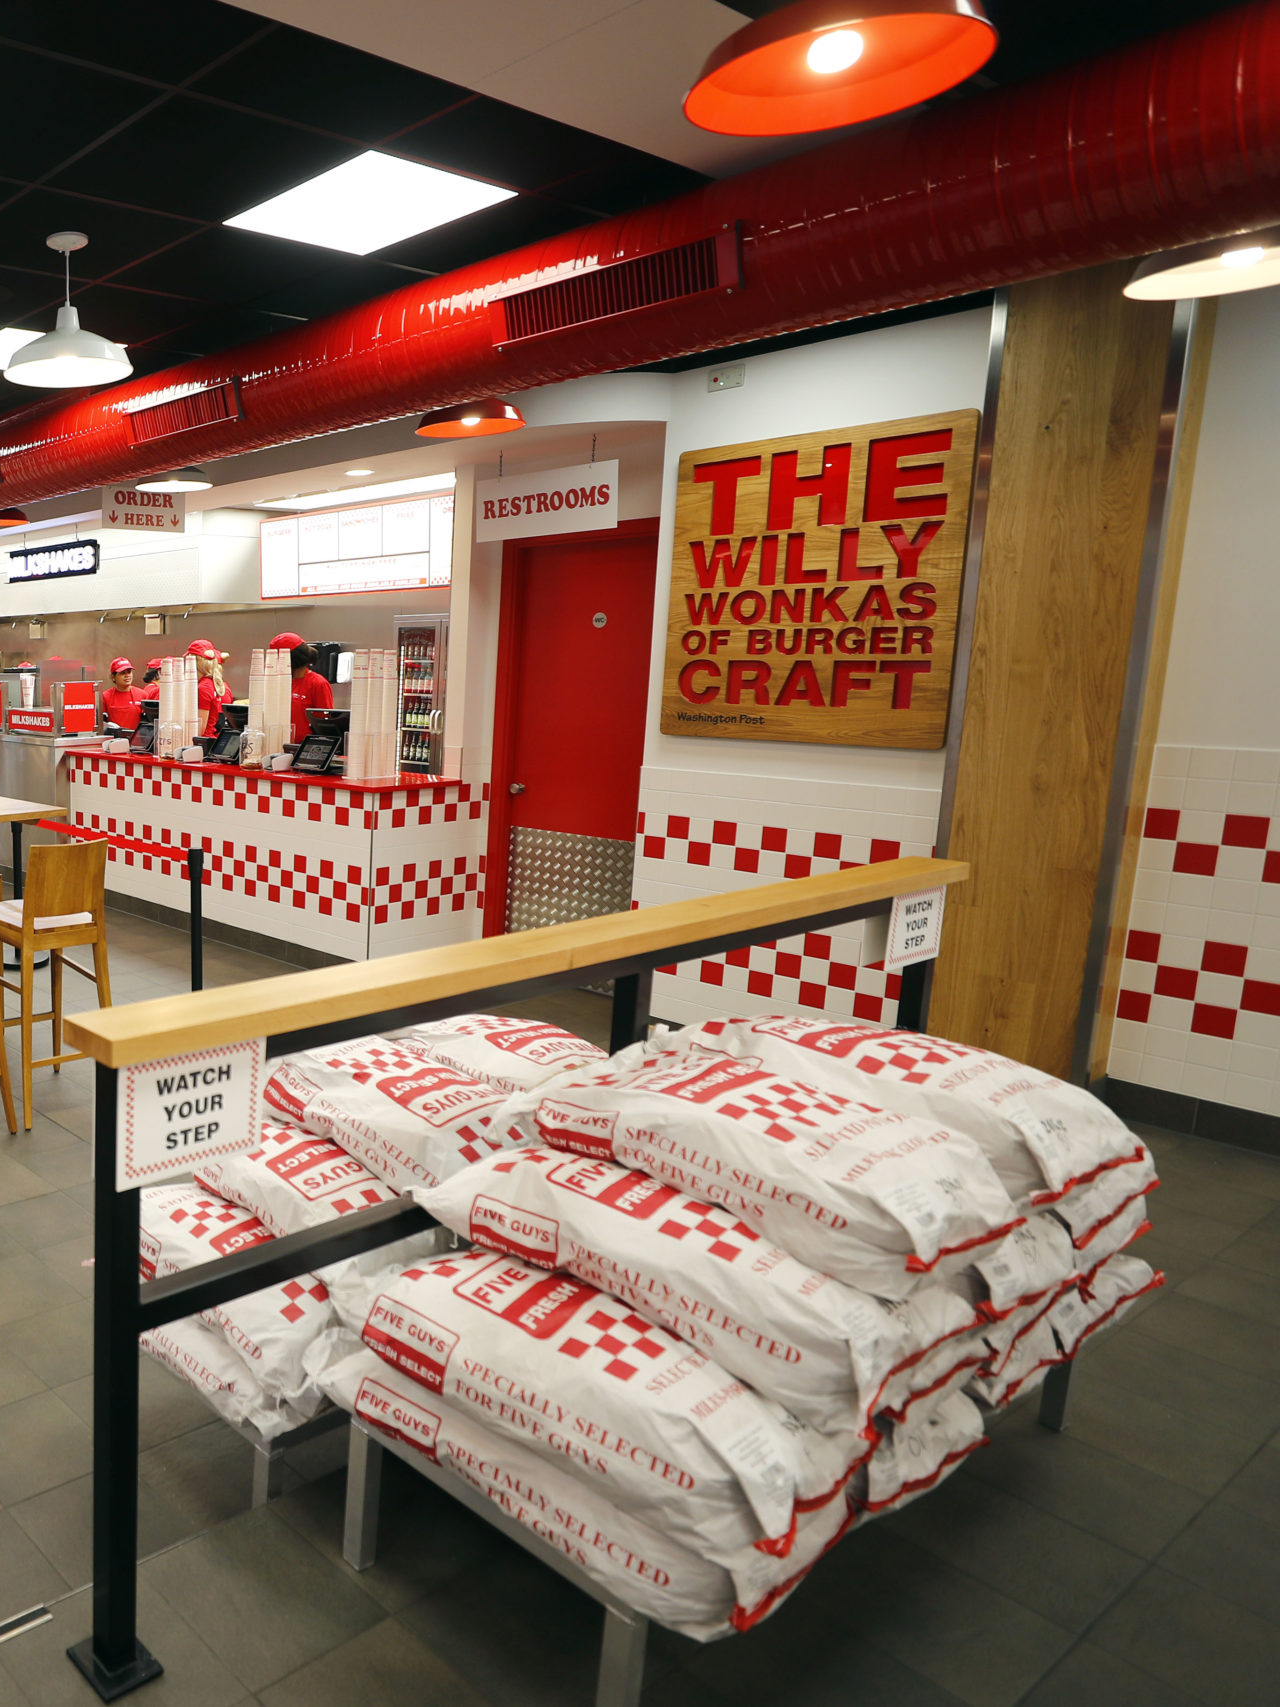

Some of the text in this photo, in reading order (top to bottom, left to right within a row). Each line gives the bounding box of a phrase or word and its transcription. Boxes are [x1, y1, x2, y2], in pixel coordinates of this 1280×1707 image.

[694, 428, 953, 536] THE
[114, 490, 174, 509] ORDER
[483, 484, 610, 520] RESTROOMS
[124, 512, 165, 527] HERE
[689, 520, 944, 588] WILLY
[685, 582, 937, 625] WONKAS
[682, 625, 934, 655] OF BURGER
[678, 659, 931, 709] CRAFT
[11, 715, 50, 726] MILKSHAKES
[677, 712, 765, 725] Washington Post
[905, 900, 933, 916] WATCH
[906, 917, 928, 932] YOUR
[904, 934, 926, 949] STEP
[529, 1041, 567, 1058] GUYS
[156, 1064, 231, 1096] WATCH
[288, 1074, 313, 1098] GUYS
[389, 1073, 440, 1098] SELECT
[164, 1094, 224, 1122] YOUR
[422, 1090, 471, 1115] GUYS
[537, 1104, 571, 1123] FIVE
[166, 1122, 219, 1149] STEP
[320, 1100, 440, 1188] SPECIALLY SELECTE
[568, 1140, 611, 1157] SELECT
[303, 1160, 364, 1189] GUYS
[364, 1147, 398, 1178] GUYS
[623, 1147, 767, 1218] FOR FIVE GUYS
[625, 1126, 727, 1175] SPECIALLY
[730, 1169, 848, 1231] SELECTED
[222, 1224, 276, 1254] ELECT
[474, 1206, 551, 1243] FIVE GUYS
[140, 1241, 157, 1256] UYS
[471, 1267, 530, 1305] FIVE
[519, 1282, 580, 1330] FRESH
[569, 1240, 802, 1365] SPECIALLY SELECTED
[373, 1306, 446, 1353] FIVE GUYS
[399, 1352, 442, 1385] SELECT
[360, 1390, 431, 1437] FIVE GUYS
[456, 1379, 608, 1474] FOR FIVE GUYS
[462, 1358, 570, 1423] SPECIALLY
[573, 1416, 695, 1491] SELECTED
[446, 1440, 550, 1511] SPECIALLY
[555, 1504, 670, 1587] SELECTED
[487, 1486, 529, 1523] FIVE
[533, 1519, 587, 1566] GUYS
